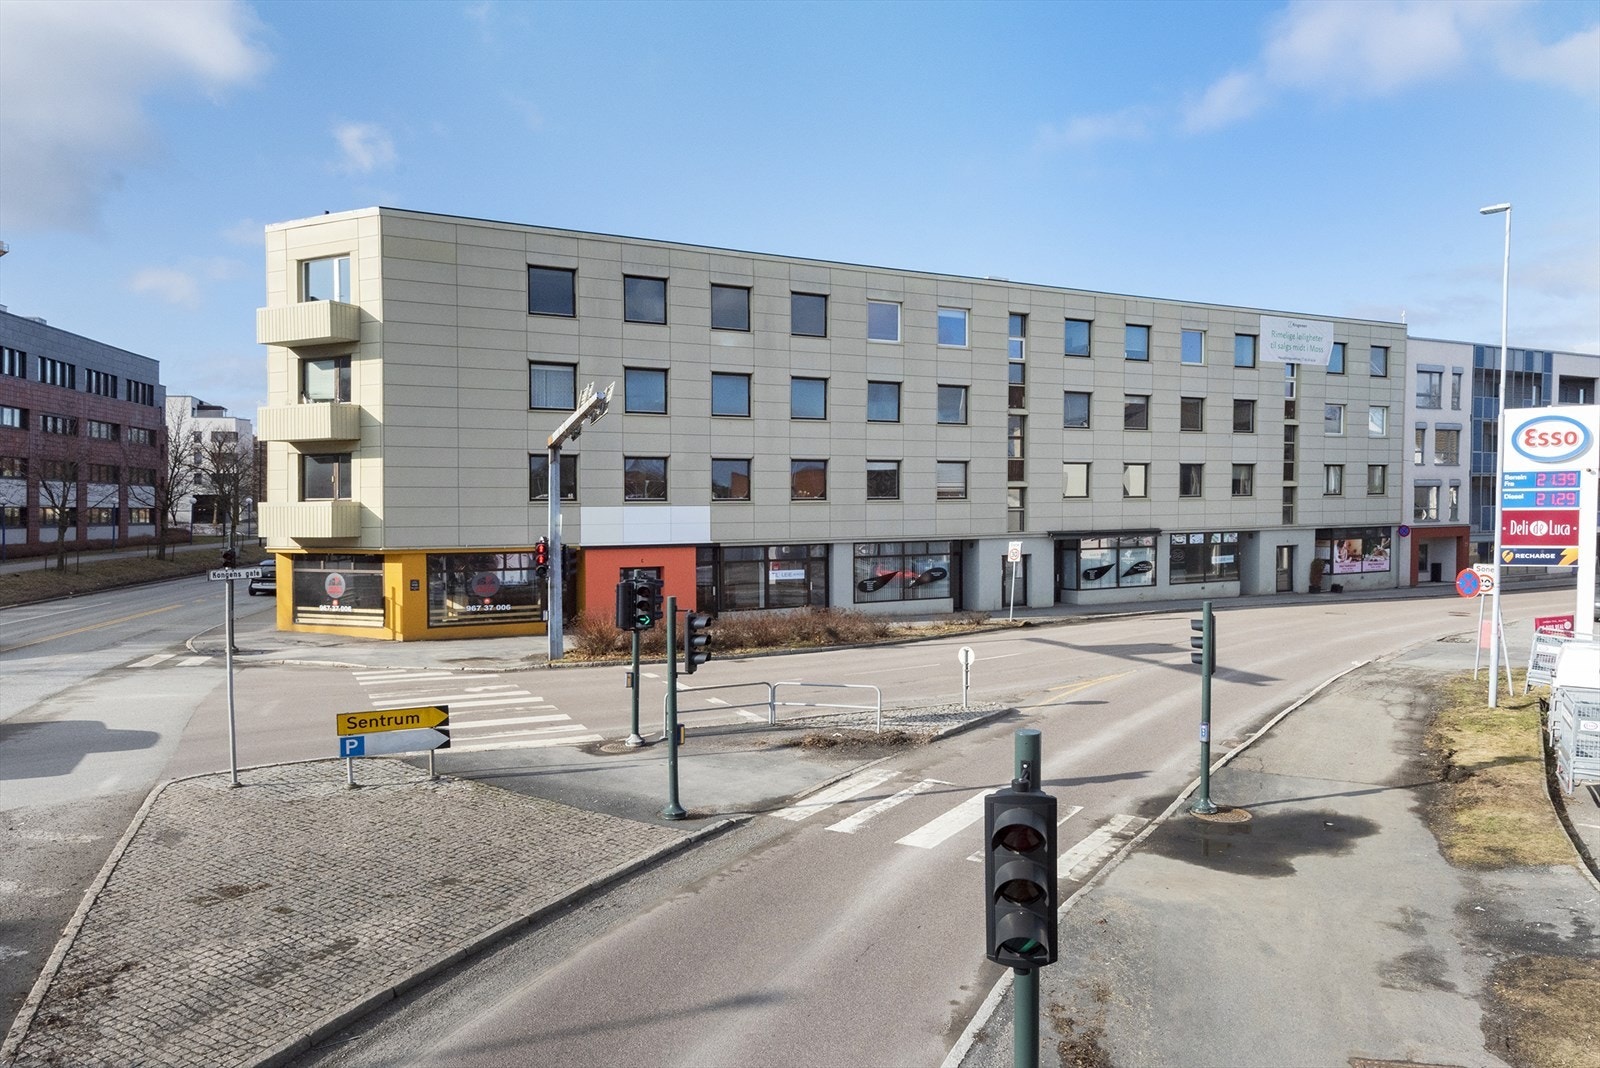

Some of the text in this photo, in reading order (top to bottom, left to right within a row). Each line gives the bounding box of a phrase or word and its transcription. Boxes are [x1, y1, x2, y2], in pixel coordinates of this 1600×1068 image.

[1271, 330, 1295, 341] Rimelige
[1277, 342, 1291, 352] salgs
[1293, 343, 1306, 351] midt
[1310, 344, 1324, 353] Moss
[1524, 428, 1578, 448] Esso
[1510, 519, 1528, 536] Deli
[1549, 521, 1570, 536] Luca
[212, 569, 260, 580] Kongens gate
[1476, 565, 1495, 573] Sone
[346, 713, 420, 730] Sentrum
[345, 739, 358, 755] P
